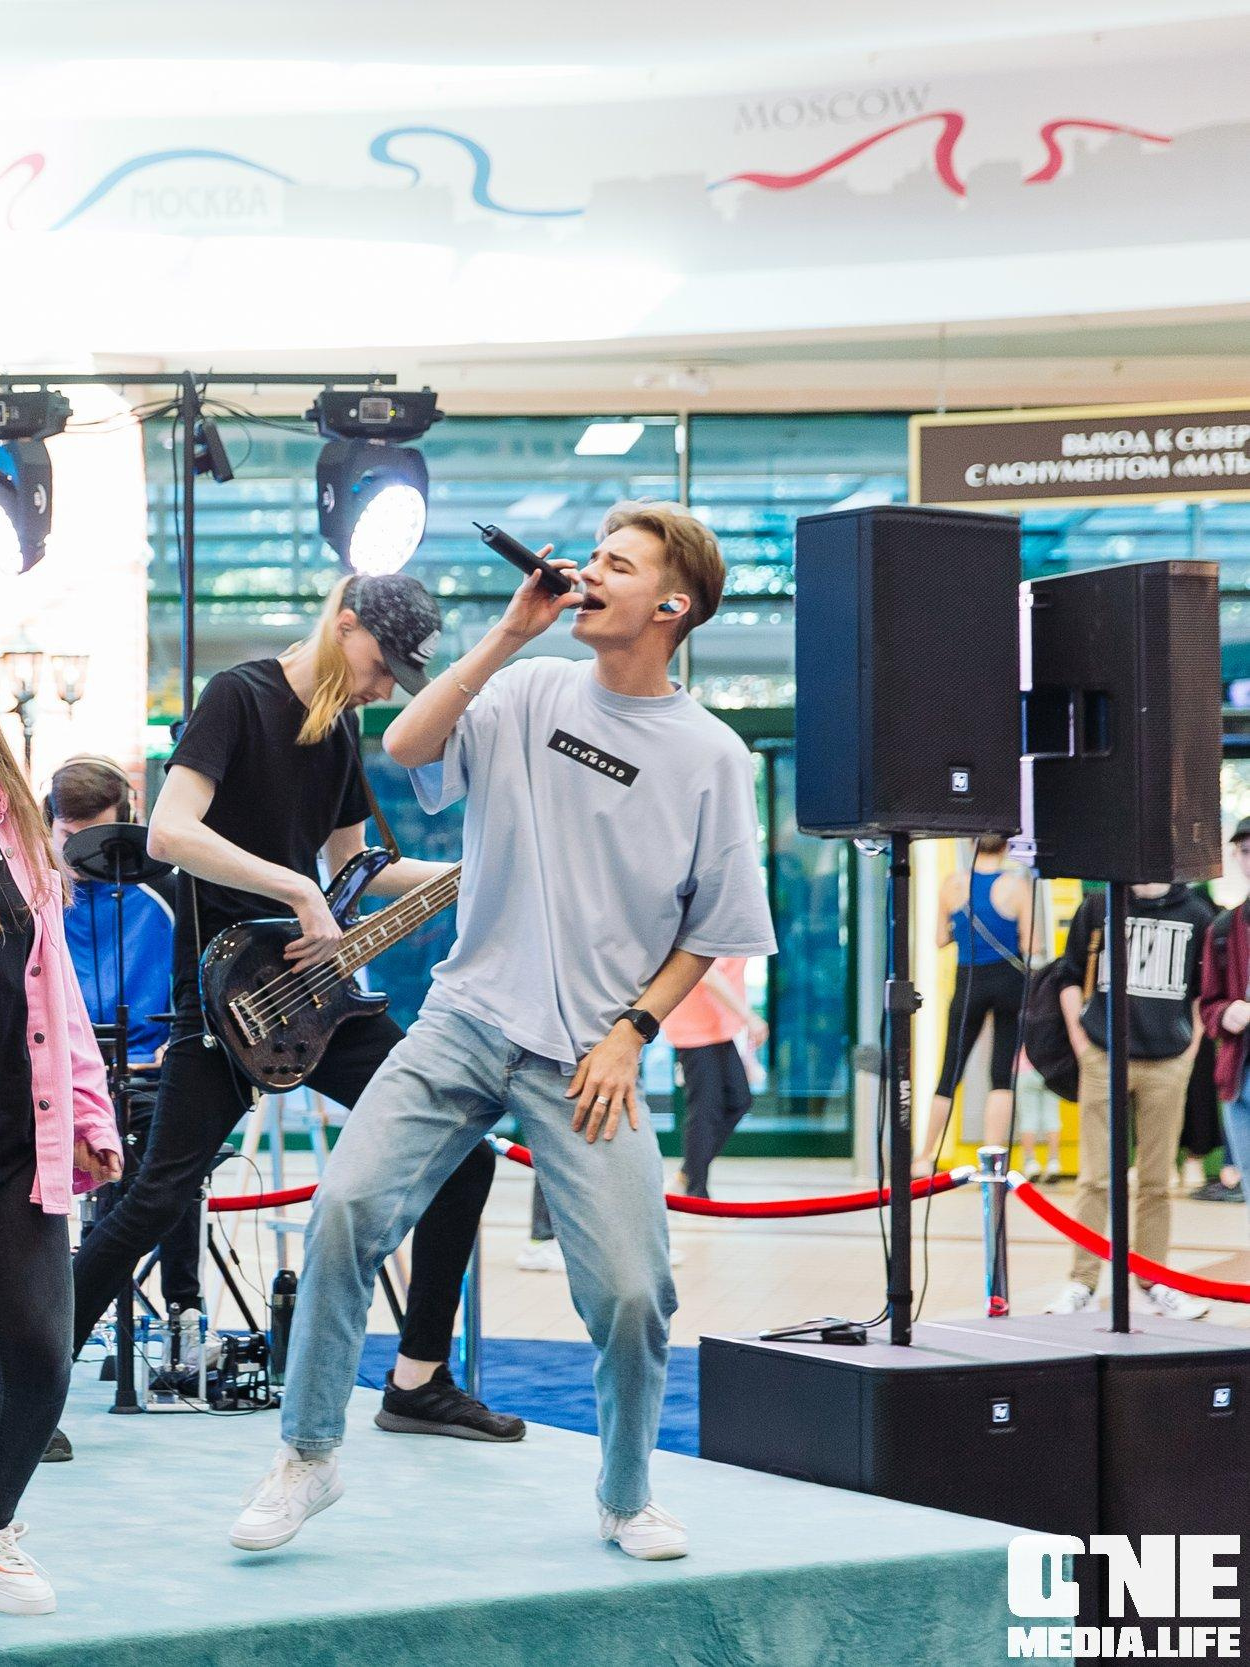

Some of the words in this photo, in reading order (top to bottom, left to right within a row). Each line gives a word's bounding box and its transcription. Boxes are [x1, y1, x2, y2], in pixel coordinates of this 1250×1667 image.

[733, 83, 931, 135] MOSCOW
[129, 183, 268, 220] МОСКВА
[1062, 430, 1152, 457] ВЫХОД
[1154, 428, 1174, 452] К
[965, 463, 985, 487] С
[986, 455, 1170, 485] МОНУМЕНТОМ
